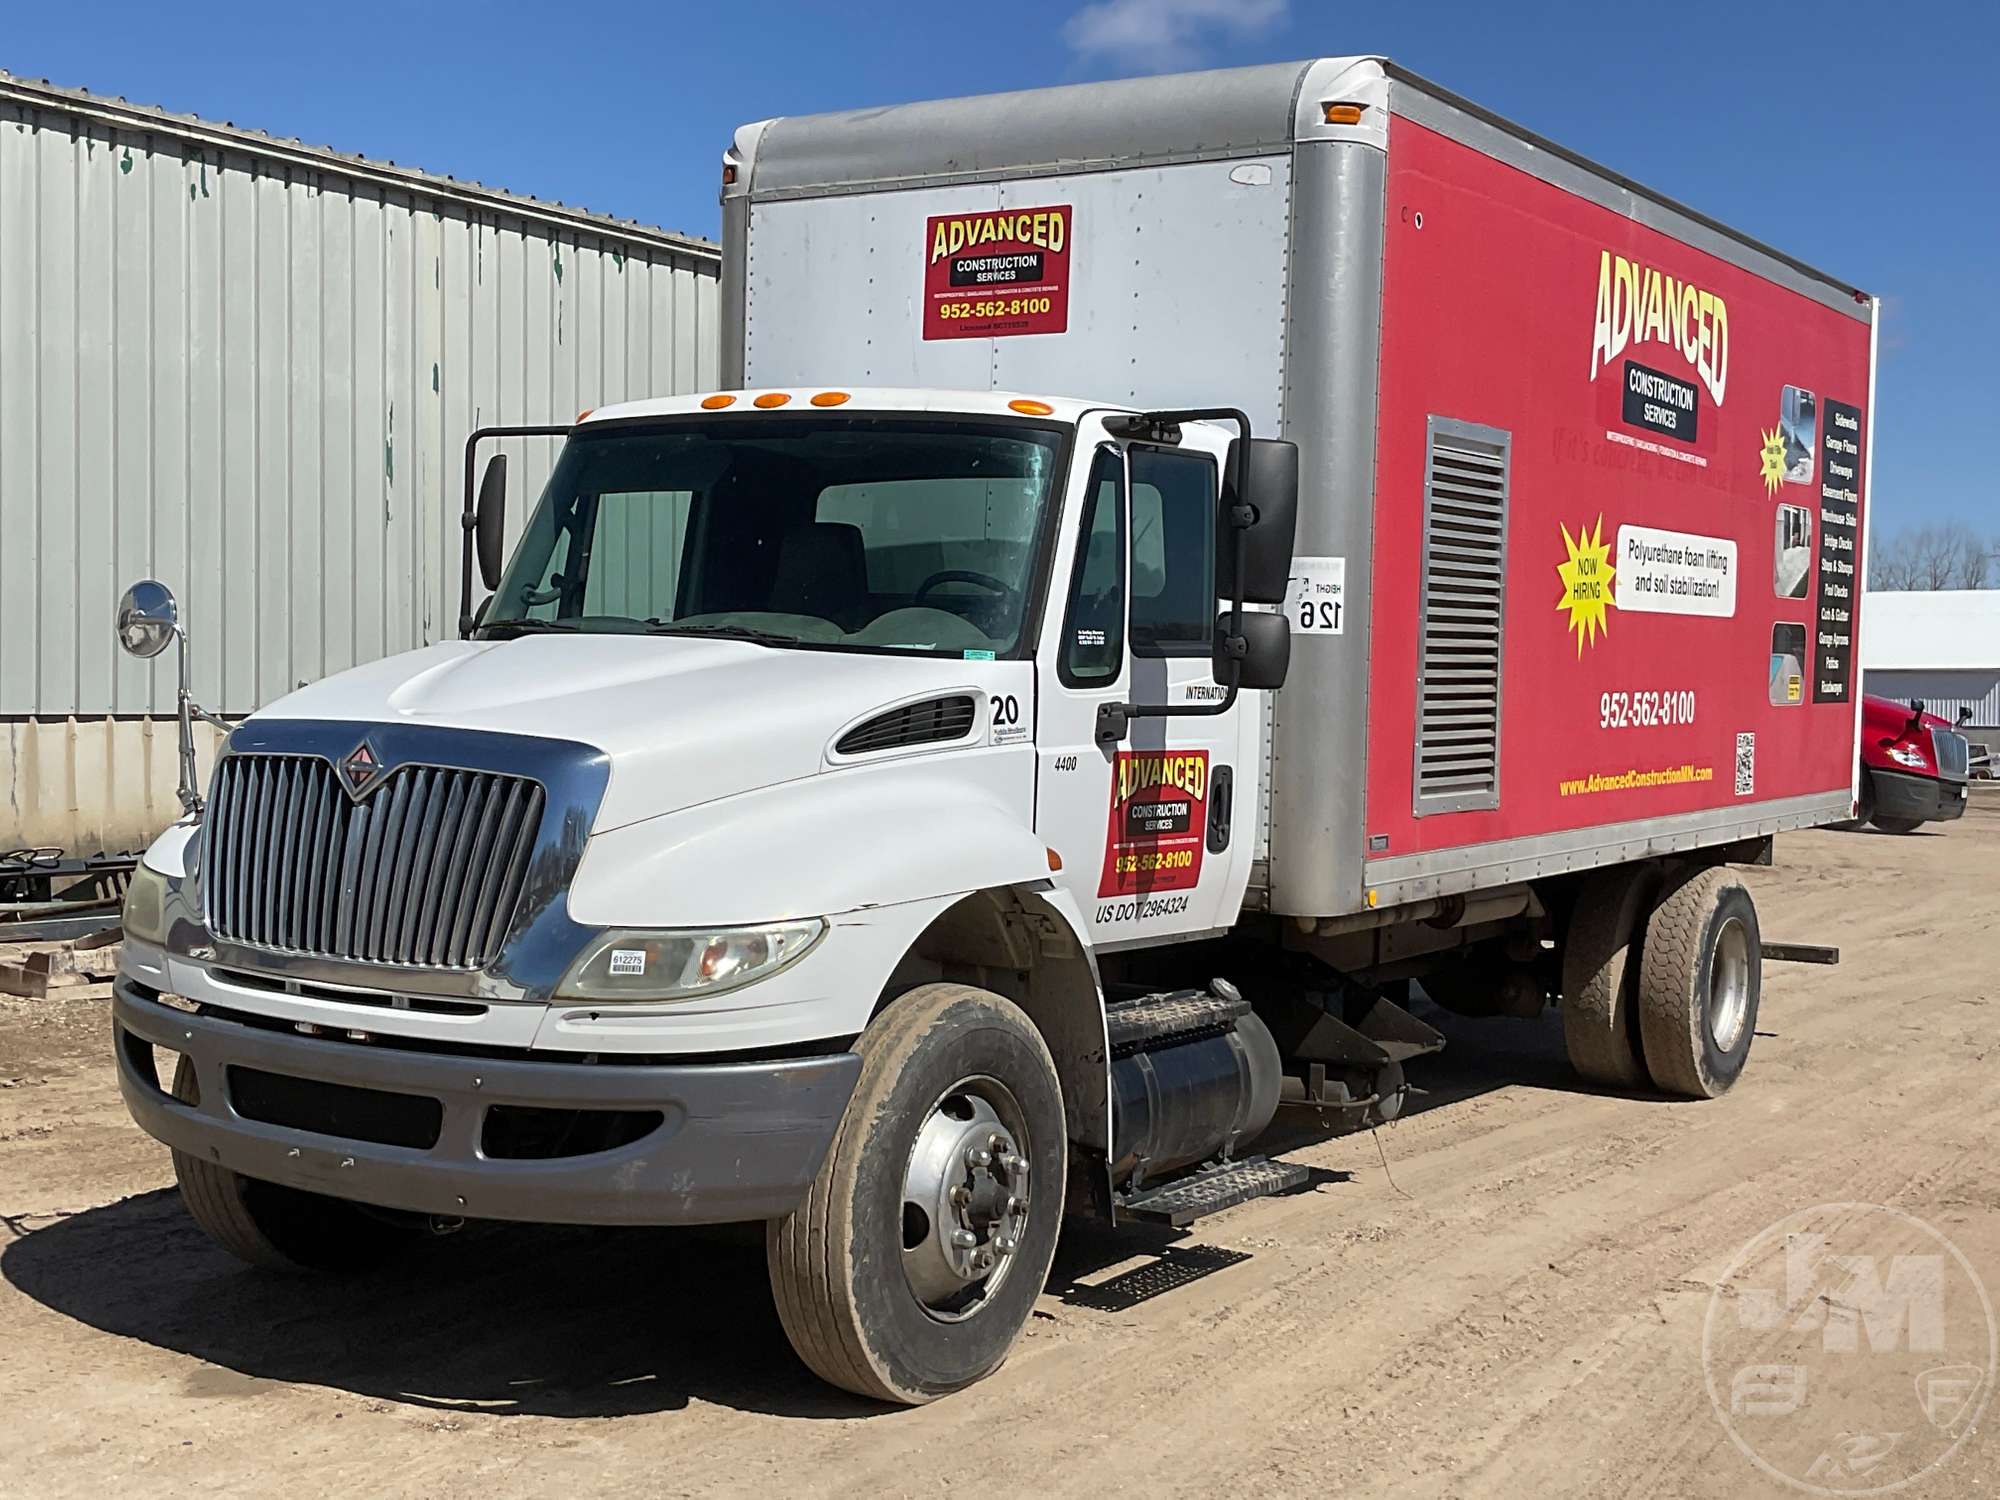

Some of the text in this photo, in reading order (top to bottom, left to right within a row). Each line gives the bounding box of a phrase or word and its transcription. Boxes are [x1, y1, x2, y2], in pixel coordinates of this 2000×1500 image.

[932, 212, 1064, 264] ADVANCED
[957, 255, 1037, 272] CONSTRUCTION
[976, 270, 1016, 282] SERVICES
[940, 298, 1050, 319] 952-562-8100
[1590, 250, 1728, 407] ADVANCED
[1629, 368, 1693, 411] CONSTRUCTION
[1644, 403, 1676, 429] SERVICES
[1577, 558, 1597, 576] NOW
[1628, 538, 1728, 575] Polyurethane foam lifting
[1573, 581, 1600, 600] HIRING
[1635, 573, 1720, 599] and soil stabilization!
[990, 694, 1019, 725] 20
[1600, 690, 1695, 728] 952-562-8100
[1054, 756, 1078, 771] 4400
[1114, 757, 1205, 809] ADVANCED
[1560, 764, 1713, 796] www.AdvancedConstructionMN.com
[1132, 803, 1188, 818] CONSTRUCTION
[1145, 819, 1173, 831] SERVICES
[1115, 850, 1192, 873] 952-562-8100
[1096, 896, 1189, 924] US DOT 2964324
[613, 955, 642, 965] 612275
